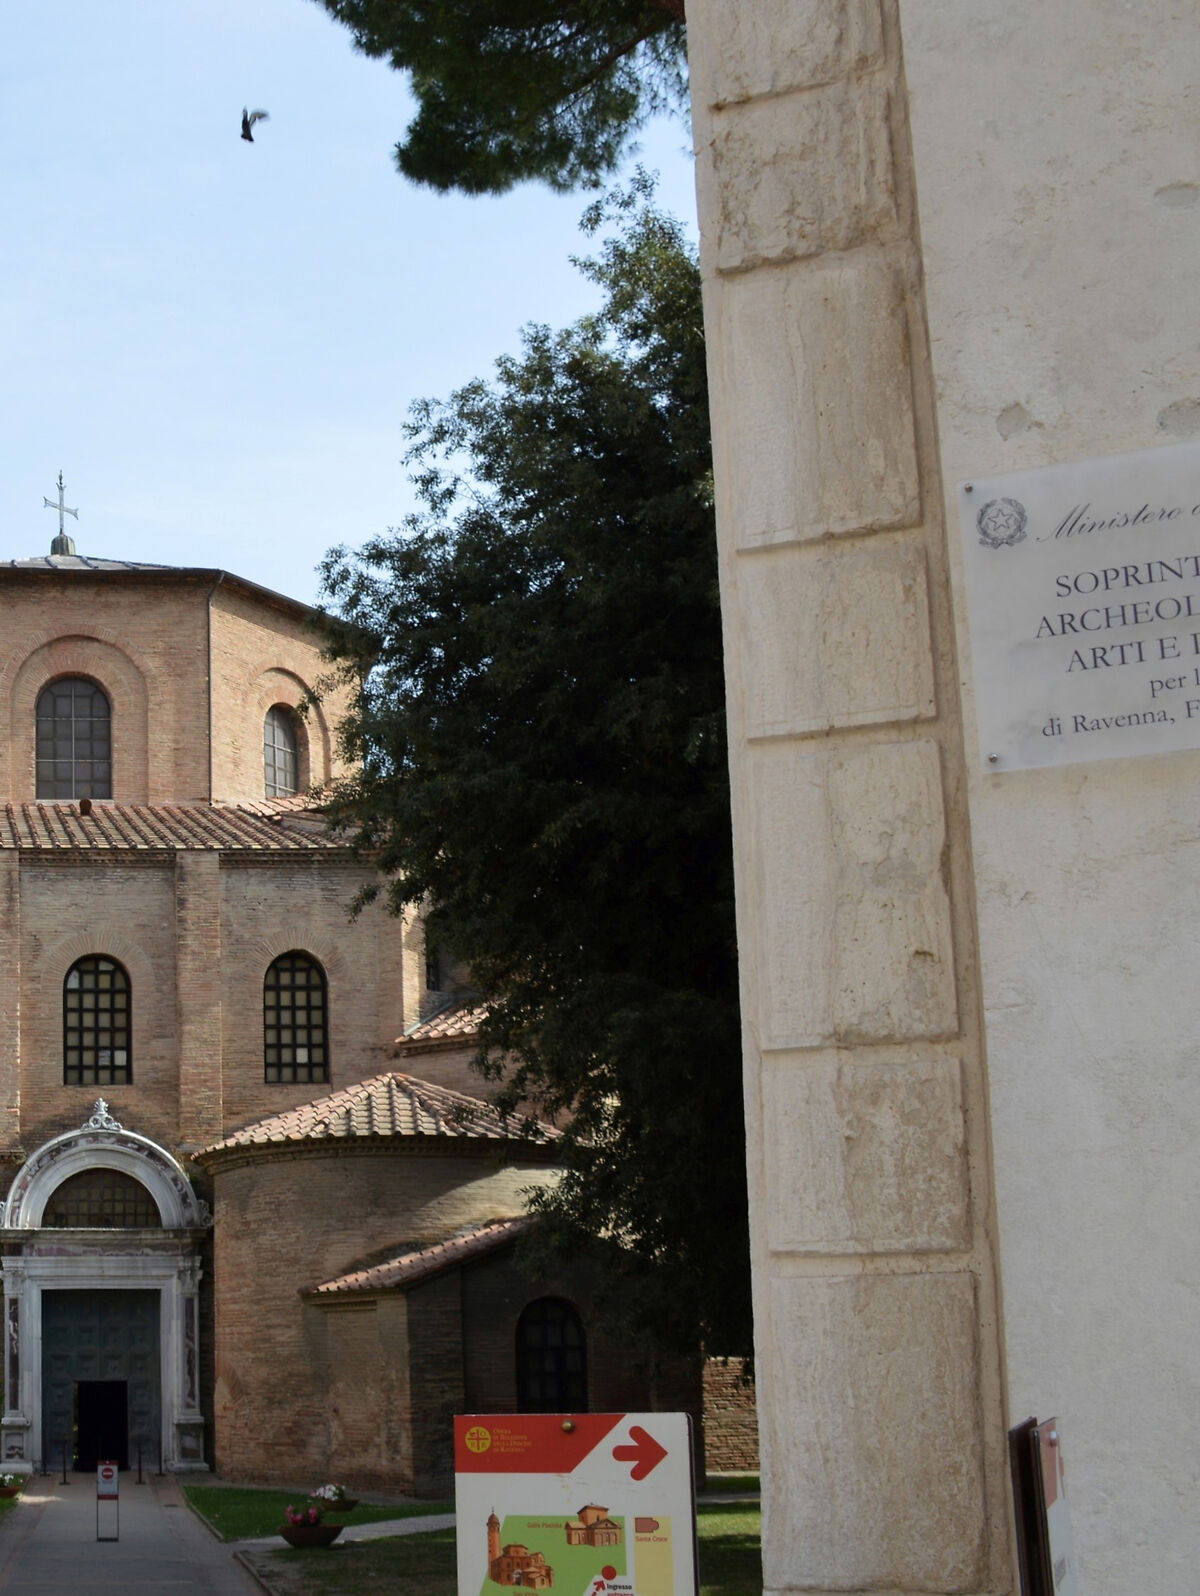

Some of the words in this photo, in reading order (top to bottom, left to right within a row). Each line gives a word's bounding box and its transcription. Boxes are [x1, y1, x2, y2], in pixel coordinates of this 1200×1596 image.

[1036, 503, 1184, 542] Ministero
[1065, 640, 1147, 673] ARTI
[1158, 636, 1181, 660] E
[1150, 675, 1187, 699] per
[1042, 716, 1063, 738] di
[1073, 708, 1176, 734] Ravenna,
